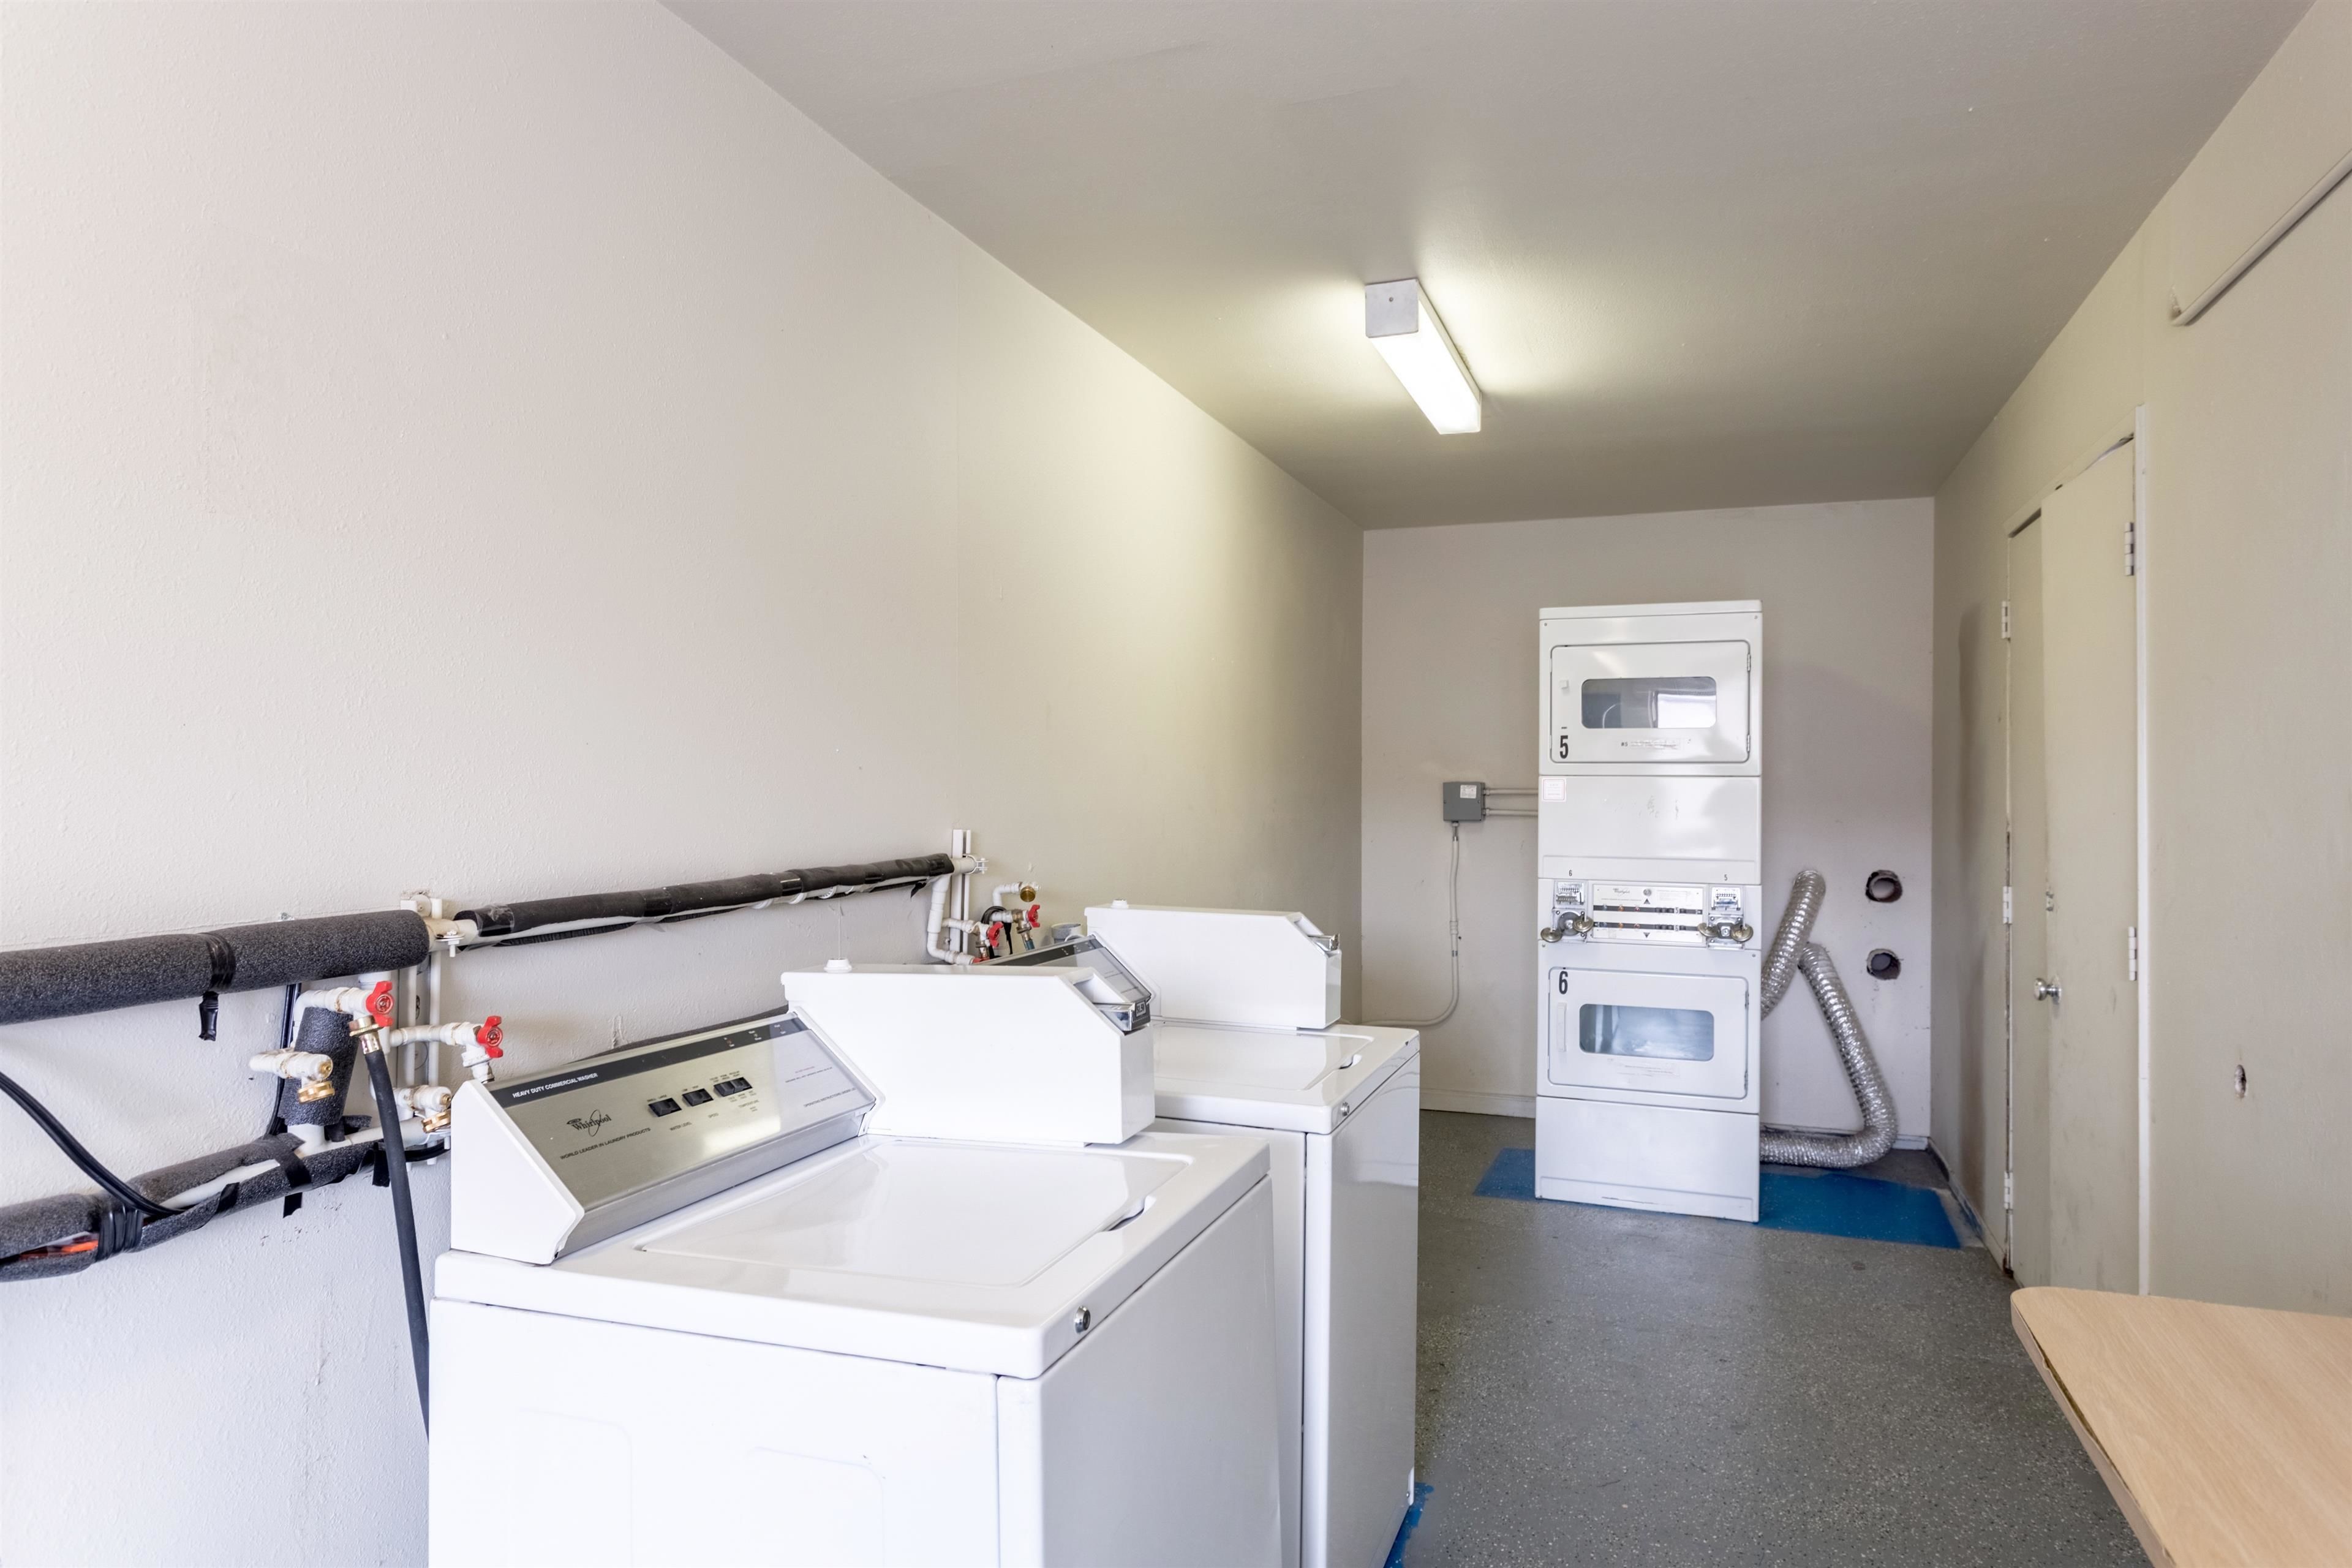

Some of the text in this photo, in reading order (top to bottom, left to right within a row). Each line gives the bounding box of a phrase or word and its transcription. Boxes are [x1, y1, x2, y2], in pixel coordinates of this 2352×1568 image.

[1559, 735, 1568, 759] 5
[1559, 970, 1568, 995] 6
[545, 1078, 578, 1090] COMMERCIAL
[577, 1072, 598, 1082] WASHER
[560, 1151, 579, 1159] WORLD
[579, 1144, 598, 1154] LEADER
[604, 1135, 626, 1146] LAUNDRY
[627, 1127, 652, 1139] PRODUCTS
